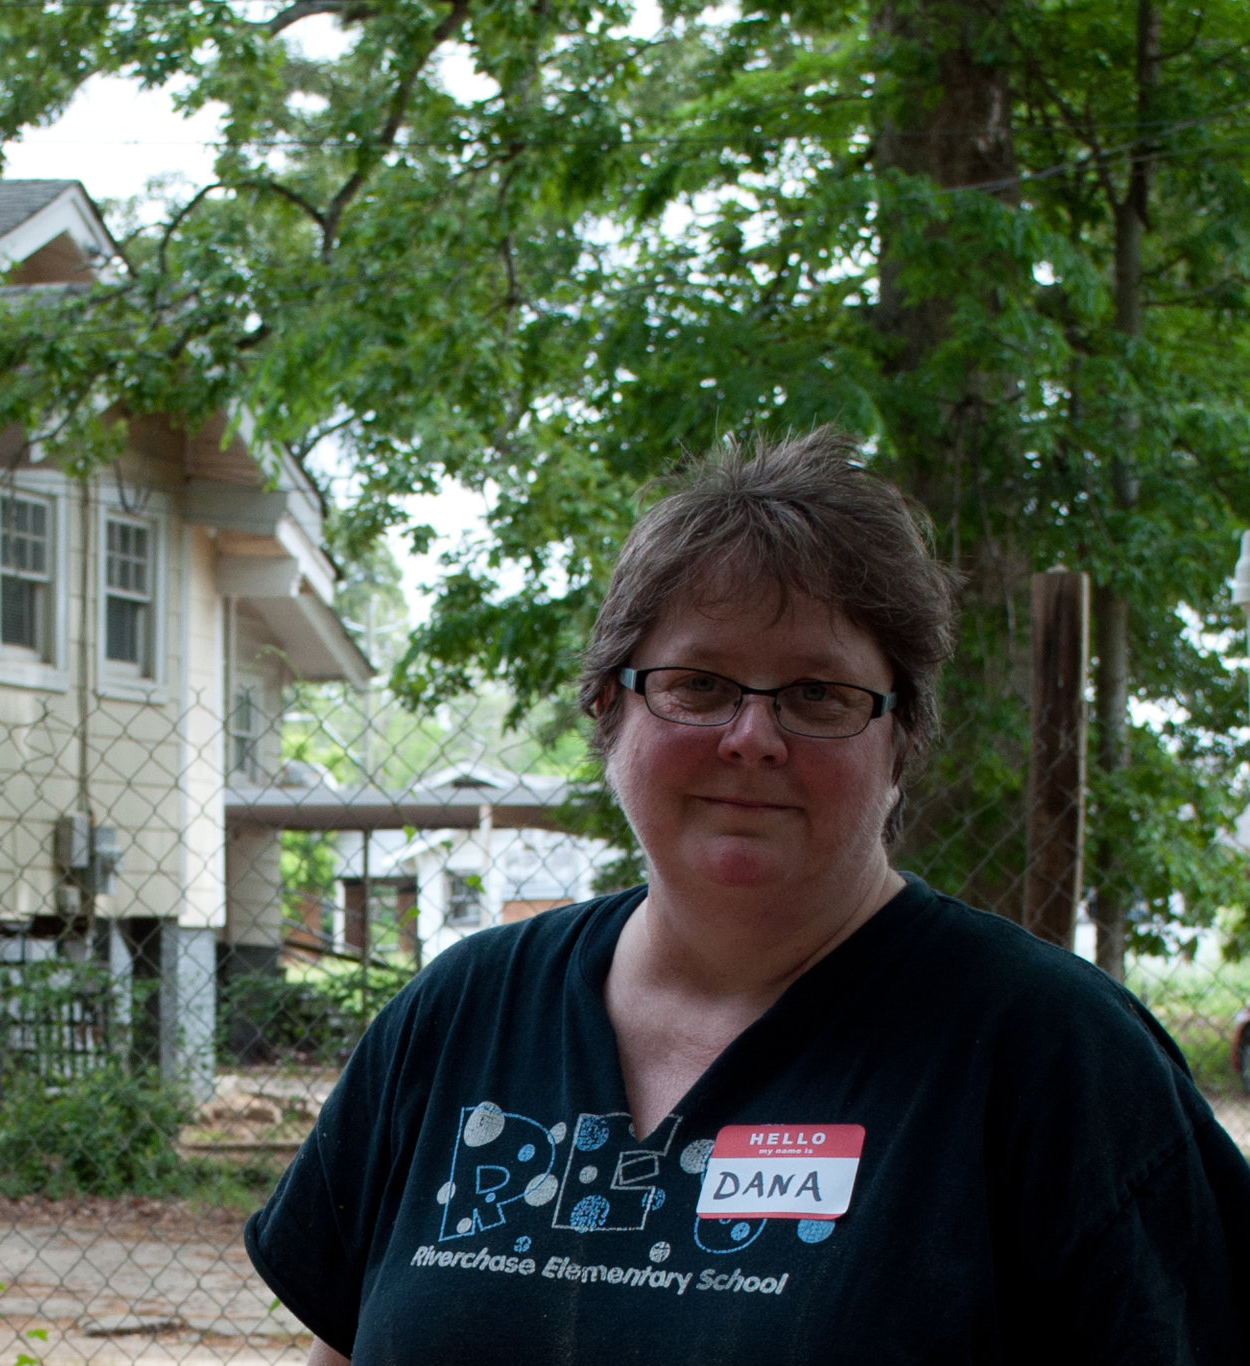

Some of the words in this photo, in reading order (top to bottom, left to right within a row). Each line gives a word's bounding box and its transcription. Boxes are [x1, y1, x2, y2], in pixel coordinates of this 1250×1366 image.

[749, 1131, 827, 1146] HELLO
[758, 1148, 773, 1156] my
[803, 1147, 814, 1155] is
[712, 1170, 823, 1203] DANA
[410, 1245, 536, 1276] Riverchase
[541, 1255, 693, 1296] Elementary
[695, 1268, 790, 1296] School
